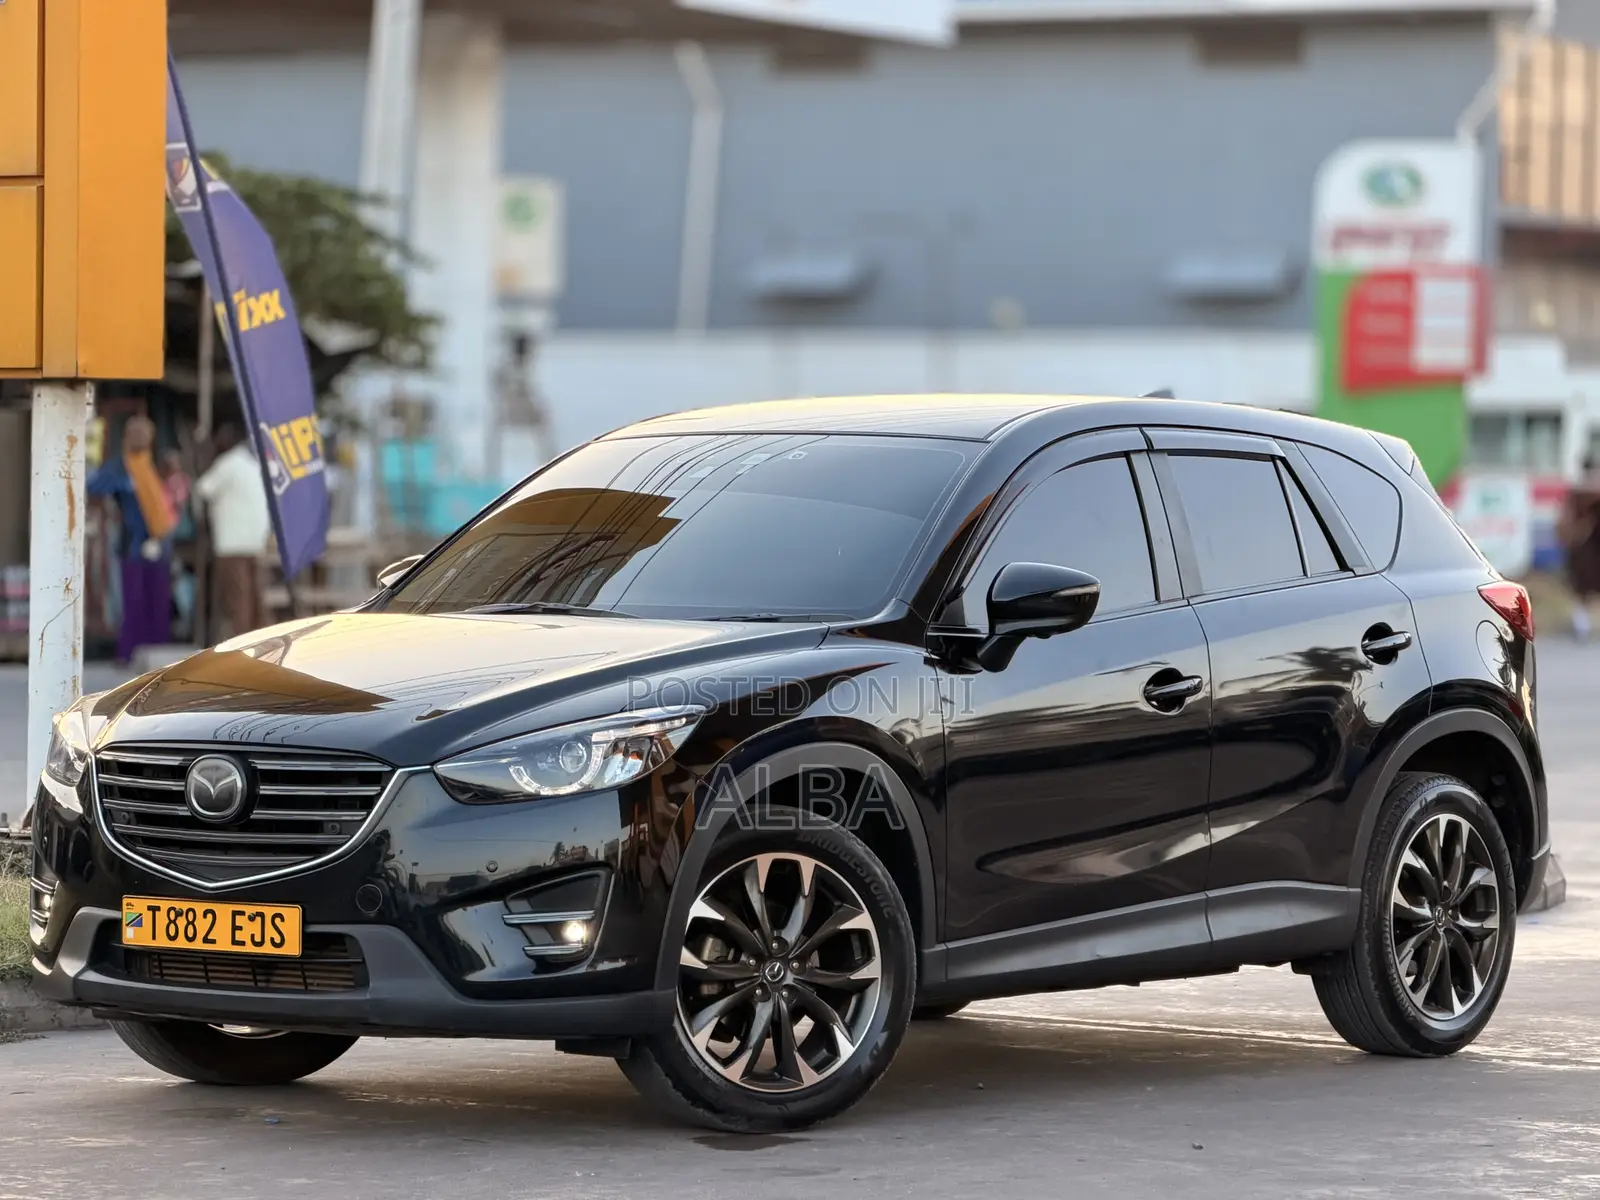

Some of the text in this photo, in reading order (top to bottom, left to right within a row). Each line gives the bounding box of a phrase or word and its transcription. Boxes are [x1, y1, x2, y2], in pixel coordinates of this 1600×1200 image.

[216, 288, 286, 337] ixx
[147, 905, 286, 949] T882 EJS
